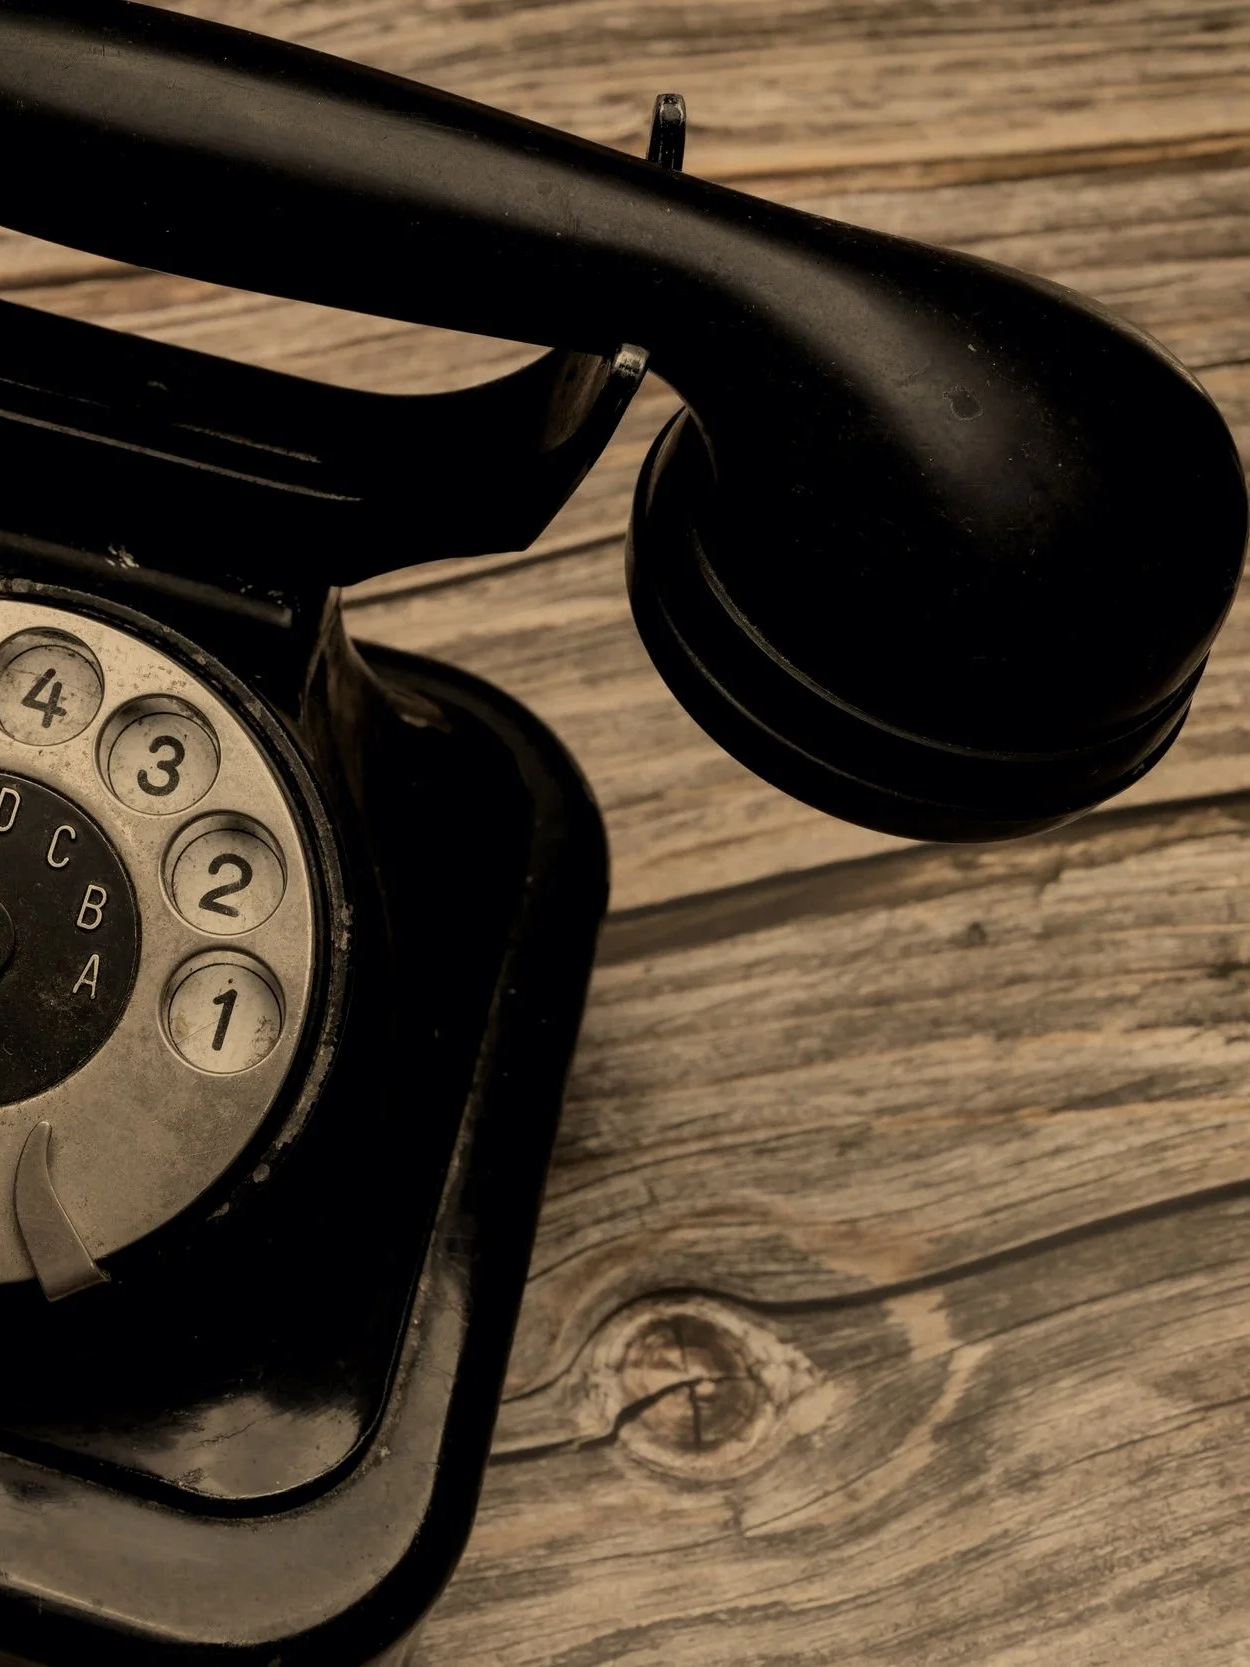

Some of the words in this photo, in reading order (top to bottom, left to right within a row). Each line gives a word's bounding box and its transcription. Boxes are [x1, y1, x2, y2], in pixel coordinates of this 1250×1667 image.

[21, 668, 67, 728] 4
[137, 735, 185, 796] 3
[47, 824, 76, 868] C
[76, 884, 107, 930] B
[199, 853, 253, 917] 2
[72, 953, 100, 999] A
[212, 989, 237, 1051] 1
